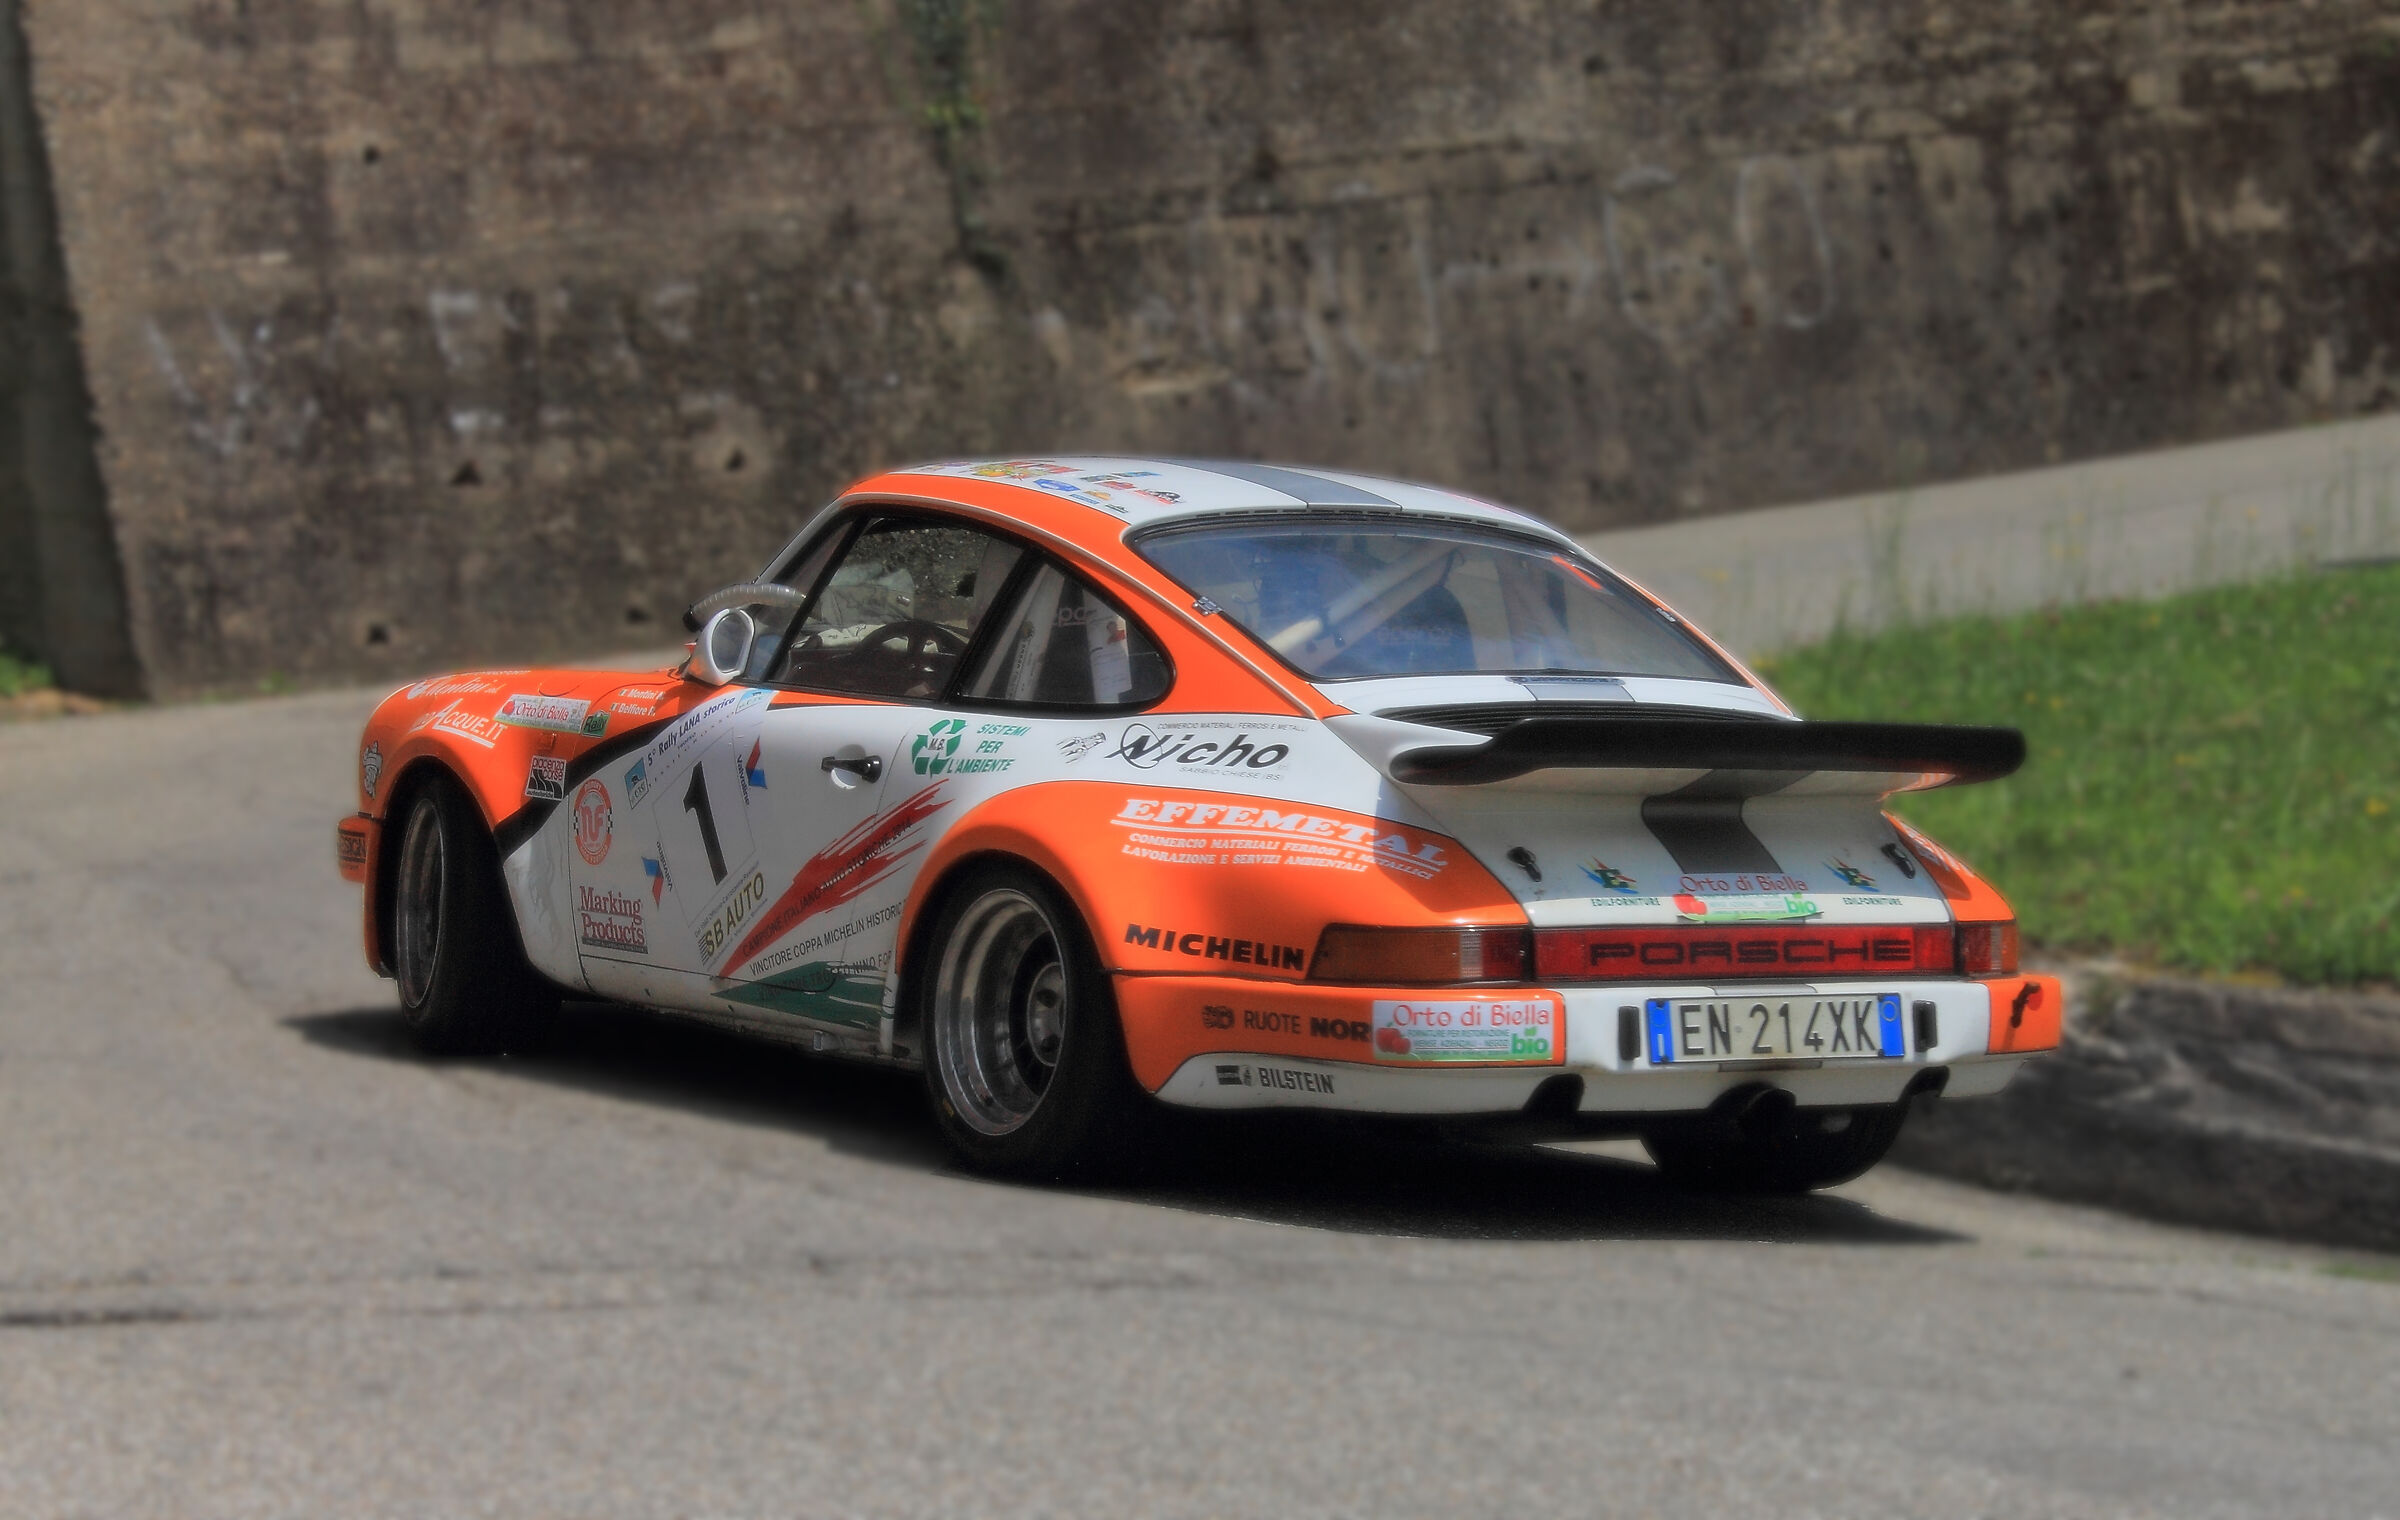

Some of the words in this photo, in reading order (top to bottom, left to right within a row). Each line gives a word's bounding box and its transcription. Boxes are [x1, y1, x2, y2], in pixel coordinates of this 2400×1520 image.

[658, 731, 678, 756] Rally
[679, 713, 701, 738] LANA
[703, 697, 736, 719] storico
[976, 723, 1032, 736] SISTEMI
[975, 740, 1005, 753] PER
[1104, 733, 1290, 769] Nicho
[683, 760, 729, 886] 1
[1117, 798, 1448, 867] EFFEMETAL
[1121, 844, 1217, 866] LAVORAZIONE
[1220, 854, 1229, 866] E
[1284, 855, 1370, 873] AMBIENTALI
[1129, 832, 1207, 850] COMMERCIO
[1210, 837, 1281, 851] MATERIALI
[1282, 842, 1342, 857] FERROSI
[1343, 849, 1356, 860] E
[1680, 874, 1730, 893] Orto
[1736, 873, 1755, 891] di
[1757, 874, 1810, 893] Biella
[579, 886, 643, 926] Marking
[725, 872, 765, 936] AUTO
[1784, 892, 1819, 915] bio
[580, 913, 646, 945] Products
[750, 947, 793, 977] VINCITORE
[793, 935, 824, 959] COPPA
[823, 919, 866, 948] MICHELIN
[1125, 923, 1305, 972] MICHELIN
[1589, 939, 1912, 967] PORSCHE
[1244, 1009, 1301, 1035] RUOTE
[1309, 1016, 1373, 1043] NOR
[1393, 1004, 1452, 1027] Orto
[1461, 1004, 1482, 1027] di
[1490, 1004, 1550, 1027] Biella
[1679, 1003, 1732, 1056] EN
[1749, 1001, 1877, 1055] 214XK
[1511, 1026, 1549, 1055] bio
[1257, 1066, 1336, 1094] BILSTEIN
